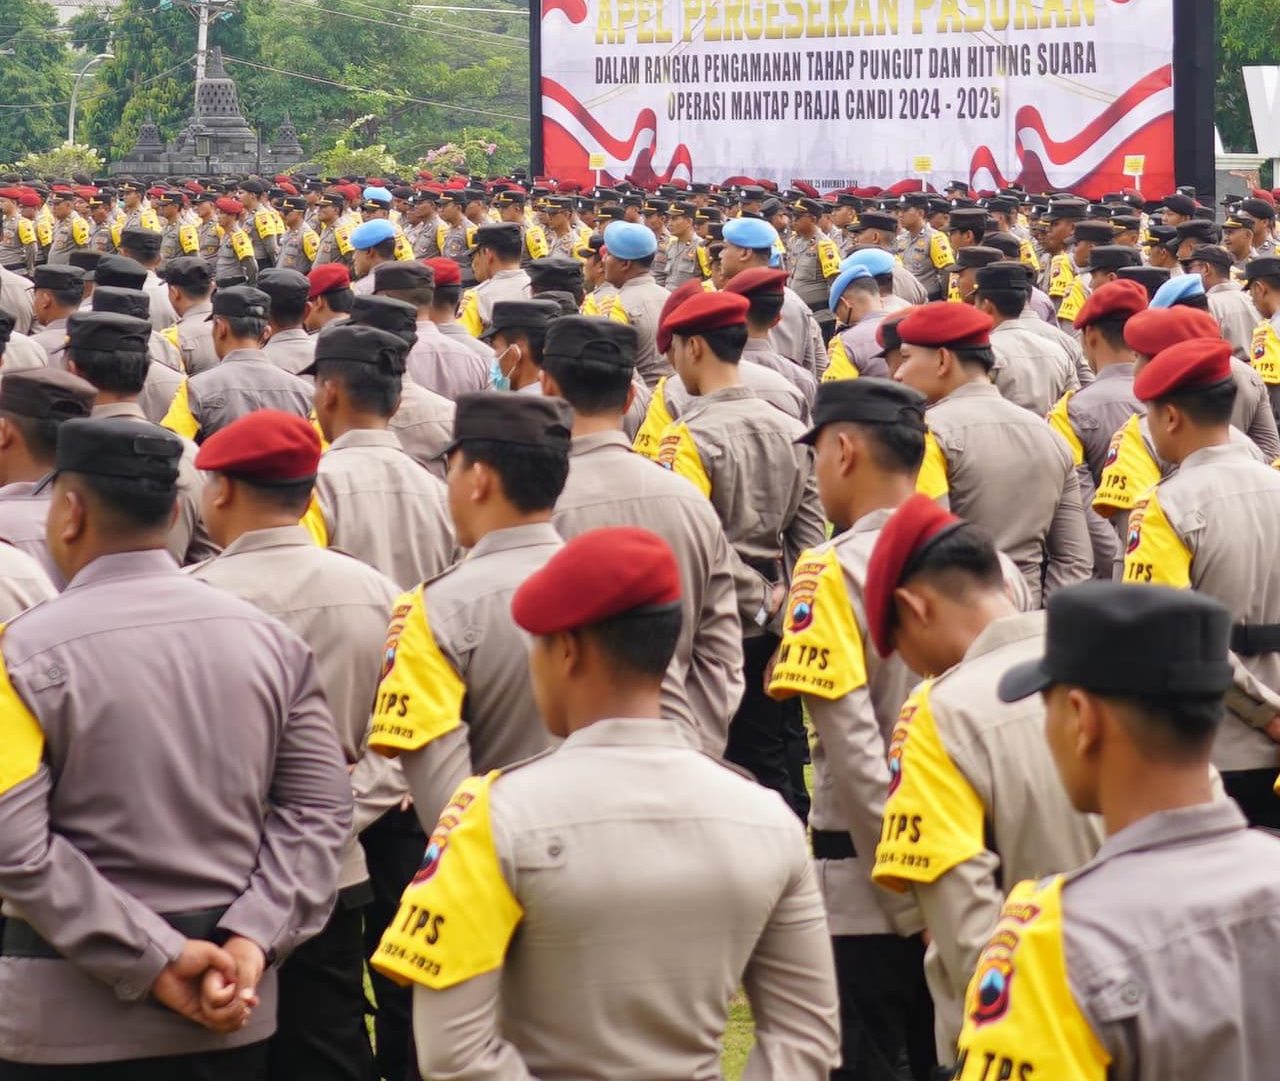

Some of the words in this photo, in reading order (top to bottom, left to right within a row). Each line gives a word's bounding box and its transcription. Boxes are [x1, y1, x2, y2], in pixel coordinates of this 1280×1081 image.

[595, 56, 640, 84] DALAM
[645, 53, 700, 84] RANGKA
[705, 51, 801, 82] PENGAMANAN
[806, 50, 855, 81] TAHAP
[860, 48, 923, 80] PUNGUT
[929, 47, 961, 79] DAN
[967, 44, 1031, 77] HITUNG
[1037, 41, 1097, 76] SUARA
[668, 91, 726, 121] OPERASI
[732, 90, 789, 121] MANTAP
[795, 89, 840, 120] PRAJA
[846, 89, 893, 120] CANDI
[900, 88, 940, 120] 2024
[957, 87, 1001, 119] 2025
[1106, 475, 1127, 490] TPS
[1129, 562, 1153, 582] TPS
[798, 645, 830, 670] TPS
[378, 692, 410, 717] TPS
[887, 815, 922, 843] TPS
[401, 904, 445, 945] TPS
